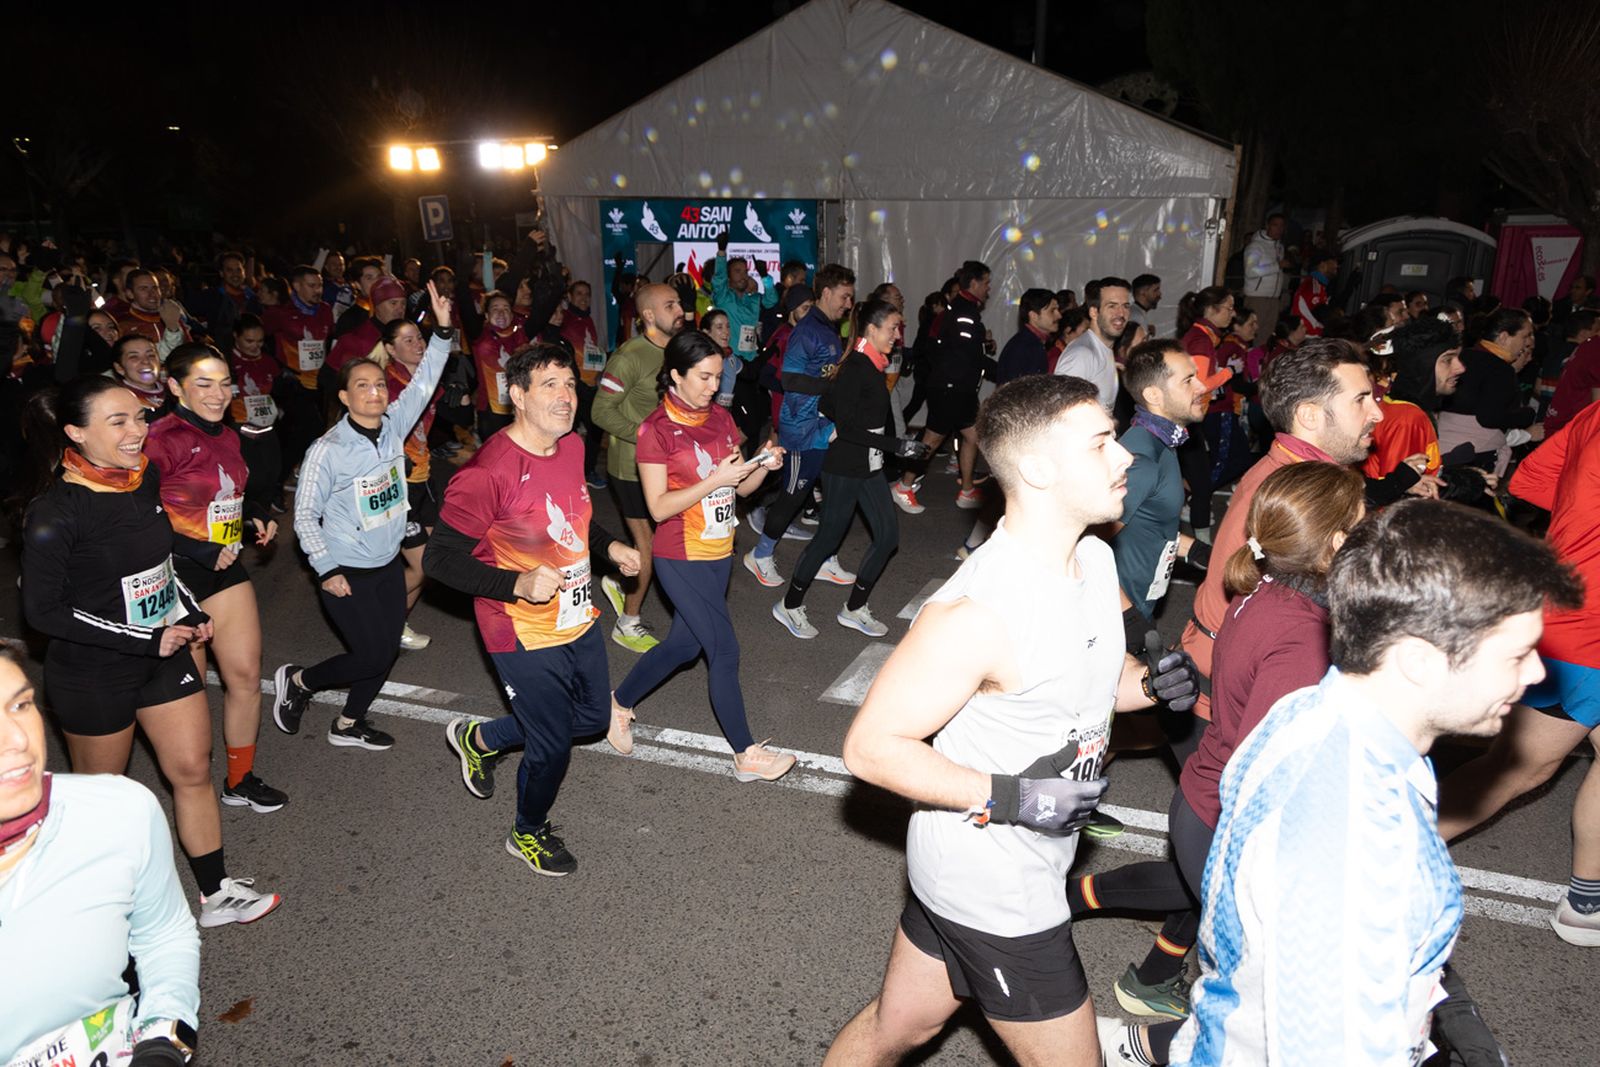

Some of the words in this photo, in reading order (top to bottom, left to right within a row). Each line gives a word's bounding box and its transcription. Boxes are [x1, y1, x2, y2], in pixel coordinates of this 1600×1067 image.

[426, 201, 445, 226] P
[681, 205, 700, 223] 43
[700, 206, 732, 222] SAN
[649, 222, 661, 236] 43
[752, 223, 764, 237] 43
[369, 483, 399, 511] 6943
[560, 528, 574, 546] 43
[134, 588, 150, 599] SAN
[46, 1036, 69, 1061] DE
